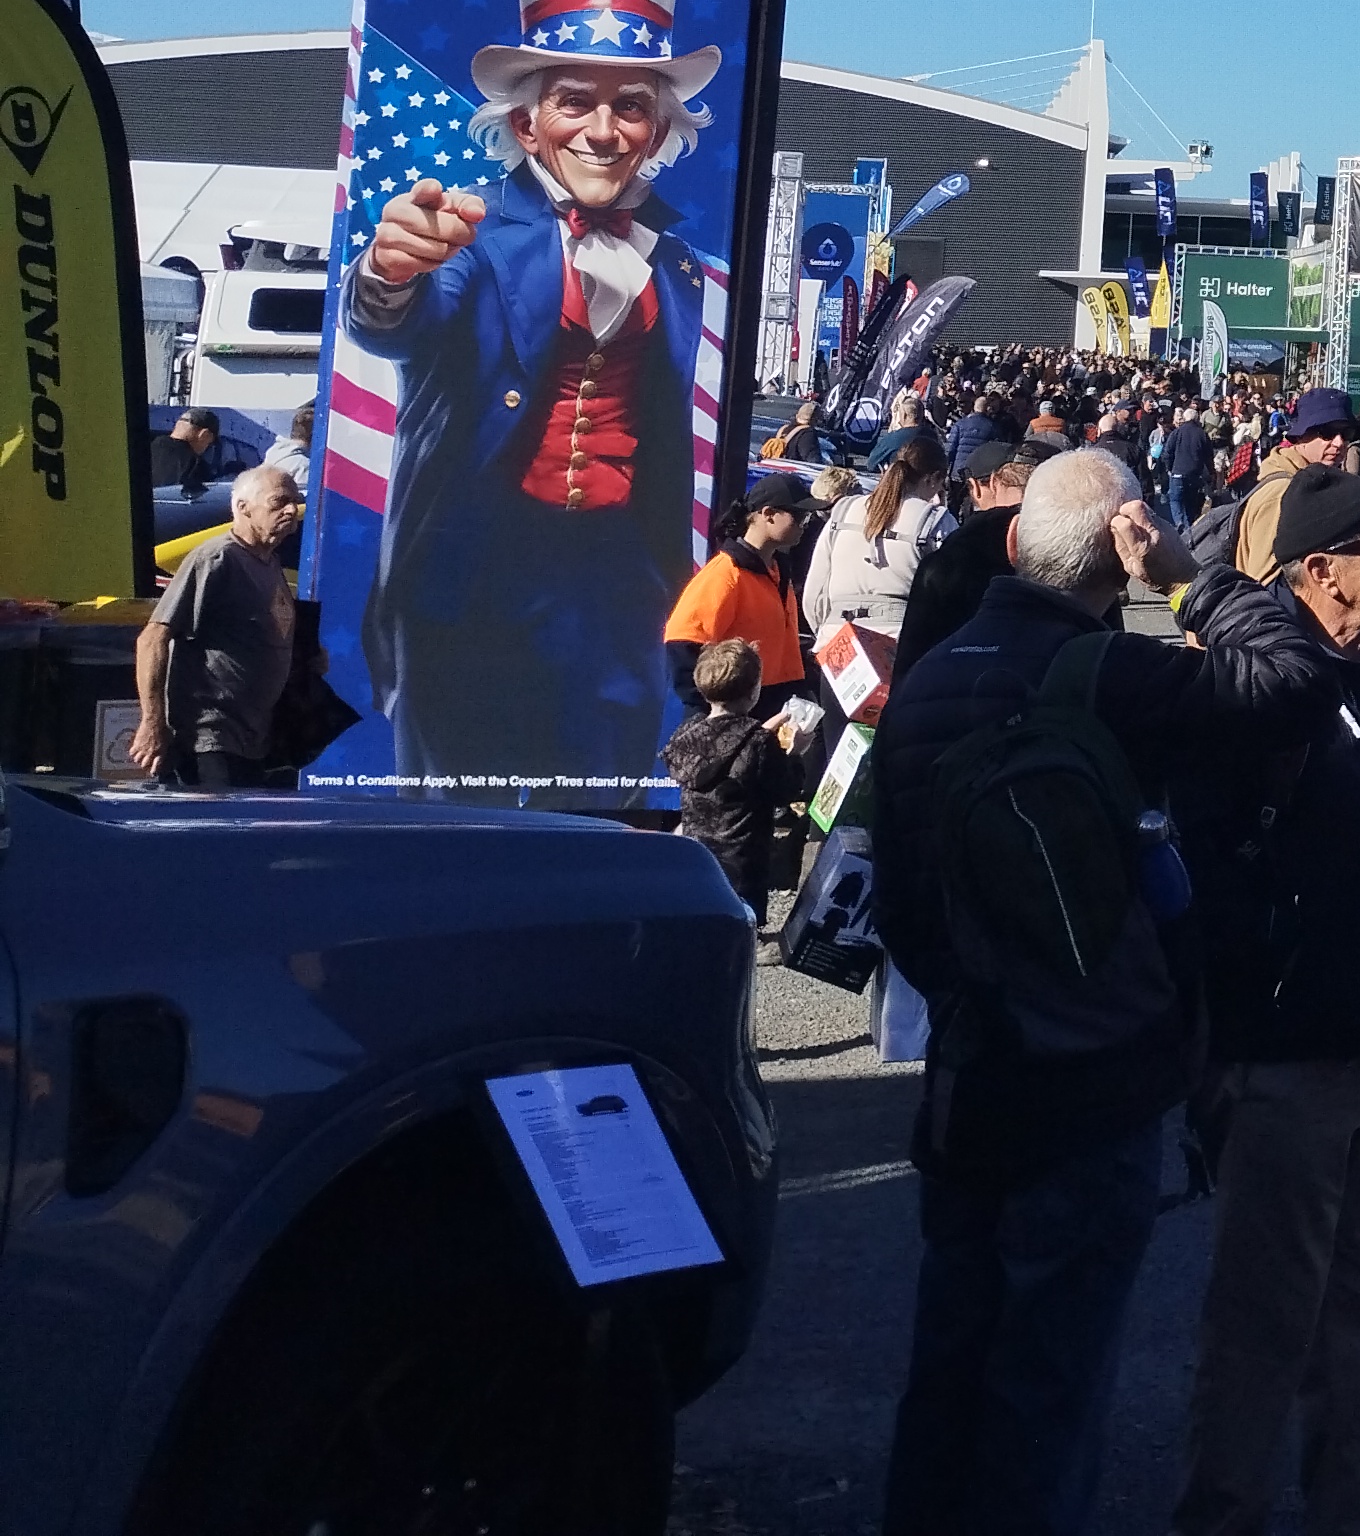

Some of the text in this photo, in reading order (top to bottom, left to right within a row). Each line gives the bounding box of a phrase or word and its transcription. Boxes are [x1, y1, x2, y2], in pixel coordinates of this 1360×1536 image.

[1226, 281, 1273, 298] Halter
[14, 188, 65, 502] DUNLOP
[307, 775, 680, 790] Terms & Conditions Apply. Visit the Cooper Tires stand for details.
